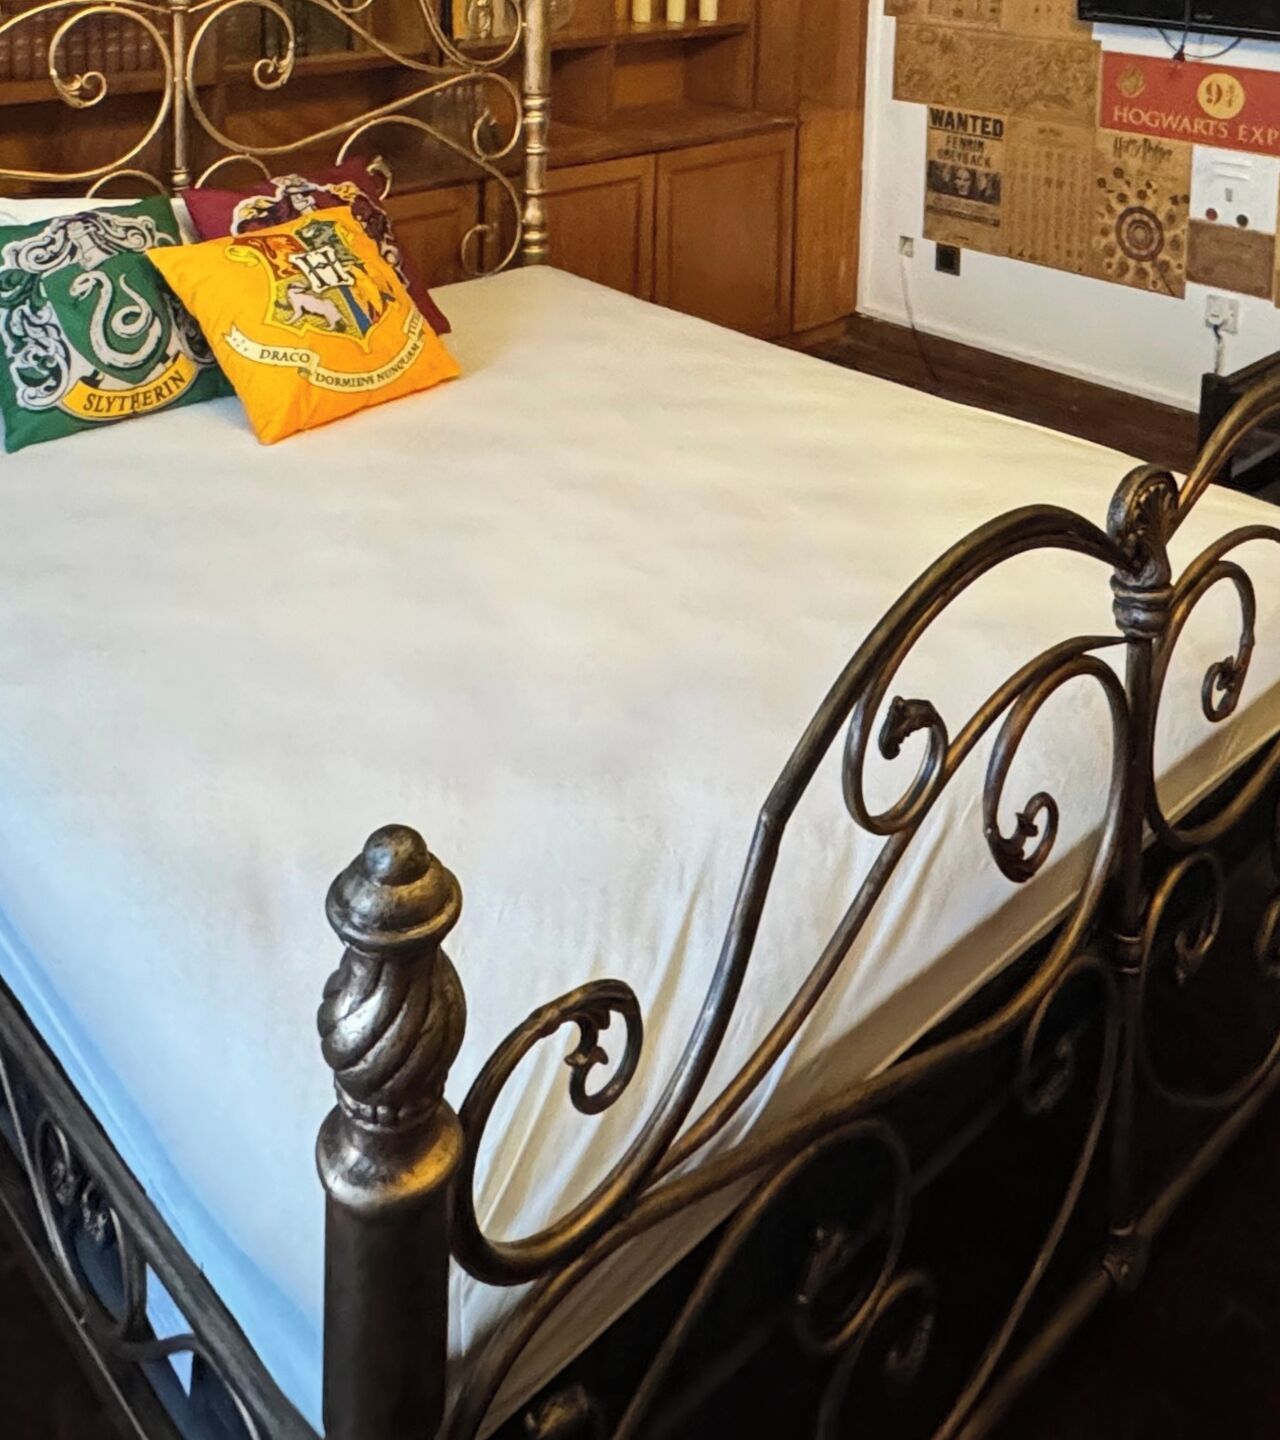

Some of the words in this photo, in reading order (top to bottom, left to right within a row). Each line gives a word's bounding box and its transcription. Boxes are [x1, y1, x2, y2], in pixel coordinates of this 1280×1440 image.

[929, 107, 1004, 138] WANTED
[1113, 106, 1229, 138] HOGWARTS
[259, 348, 311, 363] DRACO
[315, 372, 376, 388] DORMIENS
[83, 370, 186, 413] SLYTHERIN
